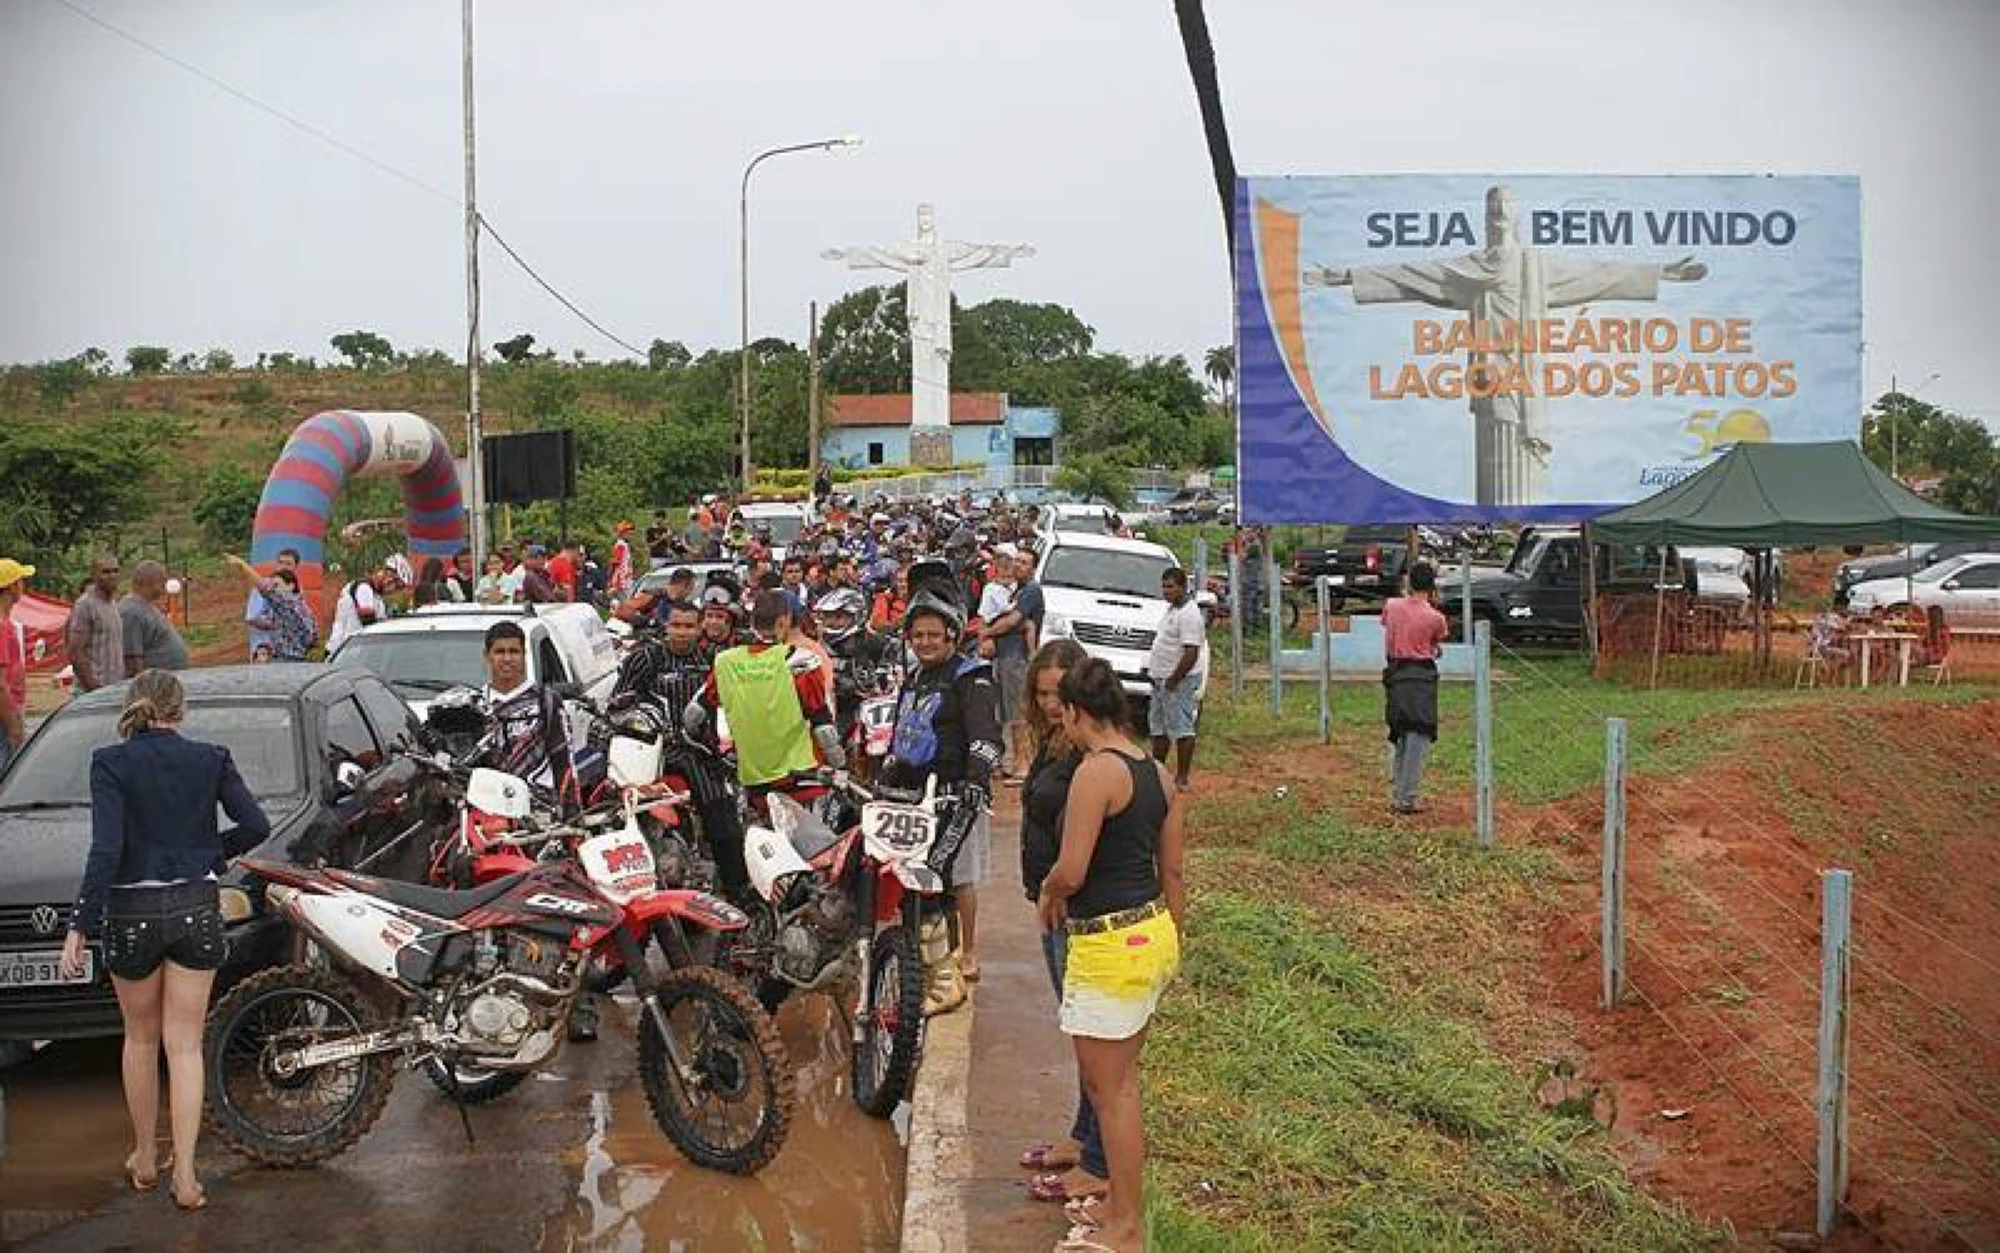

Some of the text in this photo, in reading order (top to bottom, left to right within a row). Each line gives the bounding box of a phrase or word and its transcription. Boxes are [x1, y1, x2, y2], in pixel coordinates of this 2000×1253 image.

[1367, 209, 1797, 248] SEJA BEM VINDO
[1413, 306, 1754, 354] BALNEÁRIO DE
[1369, 359, 1798, 399] LAGOA DOS PATOS
[875, 811, 929, 844] 295
